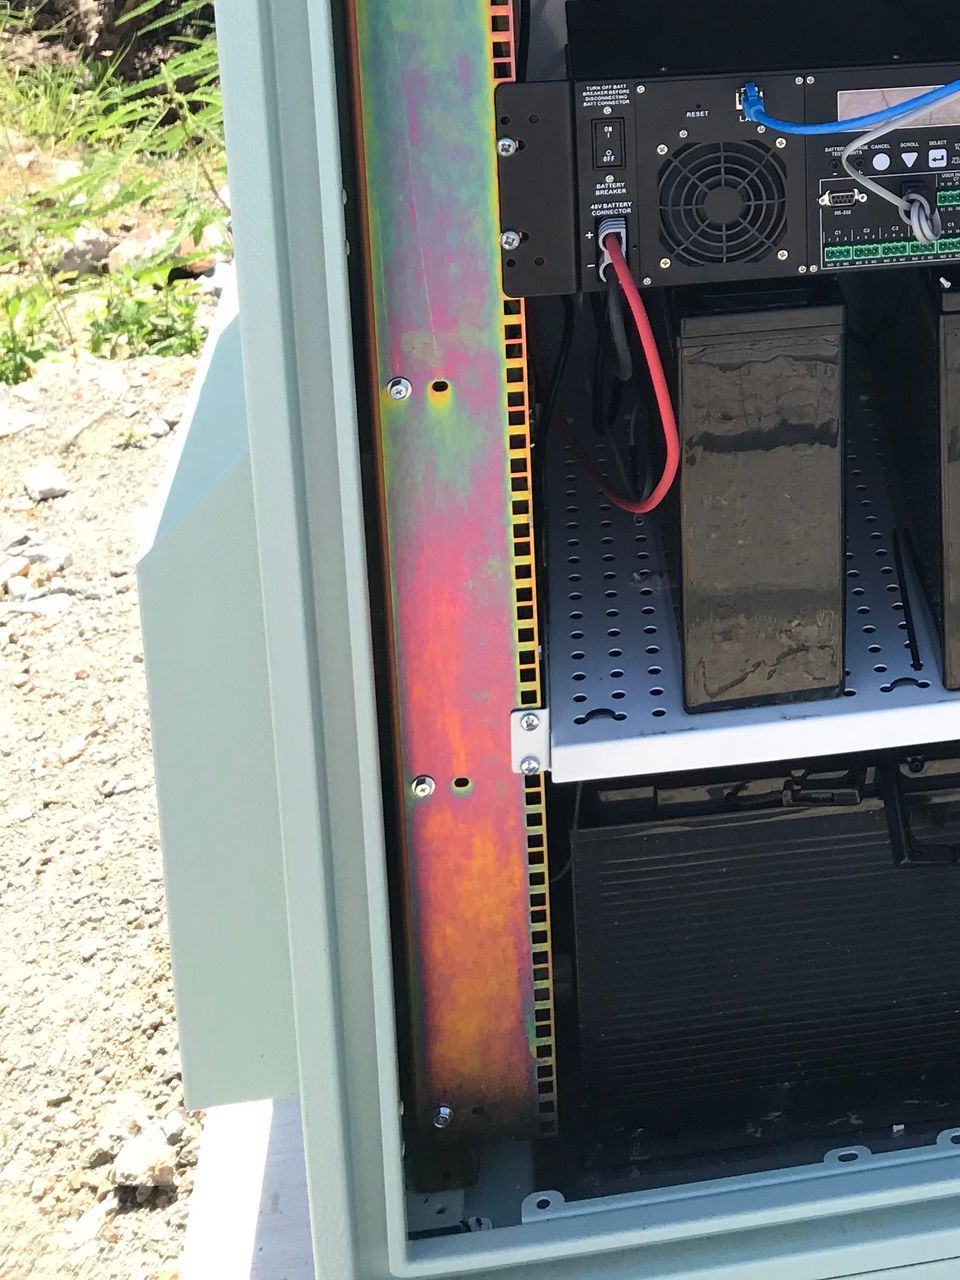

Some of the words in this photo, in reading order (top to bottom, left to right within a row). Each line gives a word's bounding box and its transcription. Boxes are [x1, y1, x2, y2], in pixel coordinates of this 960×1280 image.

[686, 110, 709, 118] RESET
[596, 181, 626, 190] BATTERY
[595, 188, 627, 196] BREAKER
[602, 201, 632, 209] BATTERY
[591, 208, 632, 216] CONNECTOR
